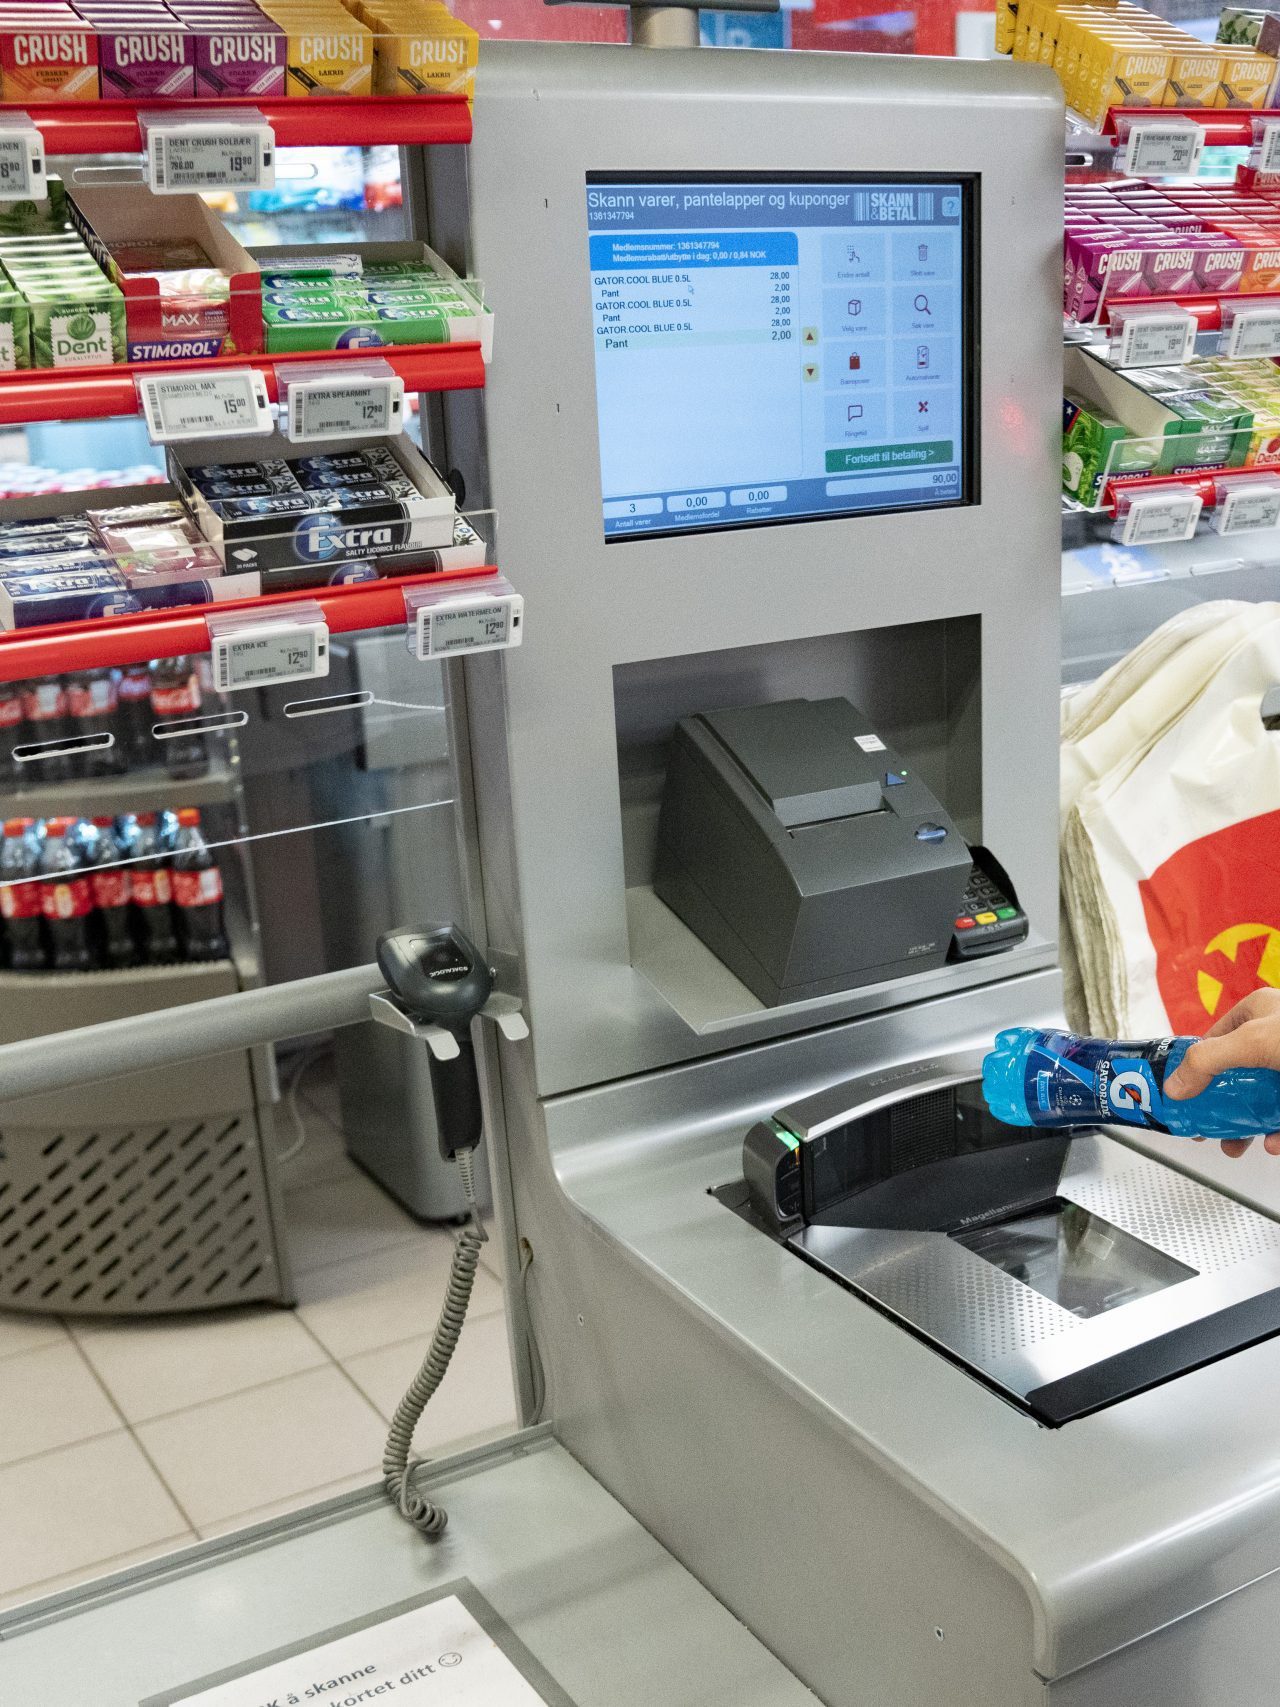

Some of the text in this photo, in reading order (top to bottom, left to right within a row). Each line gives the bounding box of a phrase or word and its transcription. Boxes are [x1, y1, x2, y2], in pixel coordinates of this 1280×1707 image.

[14, 34, 88, 66] CRUSH
[114, 34, 185, 66] CRUSH
[209, 34, 277, 66] CRUSH
[300, 34, 364, 65] CRUSH
[1126, 55, 1168, 77] CRUSH
[1179, 58, 1220, 79] CRUSH
[1231, 62, 1270, 83] CRUSH
[169, 138, 189, 147] DENT
[588, 191, 850, 211] Skann varer, pantelapper og kuponger
[870, 192, 914, 207] SKANN
[589, 211, 635, 221] 1361347794
[870, 207, 917, 221] &BETAL
[750, 250, 767, 259] NOK
[1098, 250, 1142, 275] CRUSH
[1154, 250, 1194, 273] CRUSH
[1204, 250, 1243, 273] CRUSH
[651, 275, 674, 284] BLUE
[675, 274, 692, 283] 0.5L
[770, 271, 790, 281] 28,00
[601, 284, 790, 298] Pant 2,00
[652, 300, 674, 309] BLUE
[676, 299, 692, 308] 0.5L
[770, 295, 791, 305] 28,00
[162, 313, 200, 327] MAX
[602, 307, 791, 322] Pant 2,00
[653, 324, 675, 333] BLUE
[676, 323, 693, 332] 0.5L
[771, 318, 791, 328] 28,00
[57, 336, 108, 356] Dent
[605, 331, 792, 349] Pant 2,00
[132, 342, 213, 361] STIMOROL
[308, 389, 371, 400] EXTRA SPEARMINT
[845, 449, 927, 465] Fortsett til betaling
[932, 473, 957, 484] 90,00
[341, 488, 387, 501] xtra
[629, 490, 770, 513] 3 0,00 0,00
[615, 519, 634, 529] Antall
[308, 525, 393, 553] Extra
[345, 547, 366, 557] SALTY
[367, 545, 393, 555] LICORICE
[435, 607, 502, 622] EXTRA WATERMELON
[232, 641, 268, 652] EXTRA ICE
[1098, 1060, 1110, 1118] GATORADE
[1109, 1071, 1153, 1113] G
[400, 1662, 437, 1686] ditt
[287, 1662, 377, 1705] å skanne
